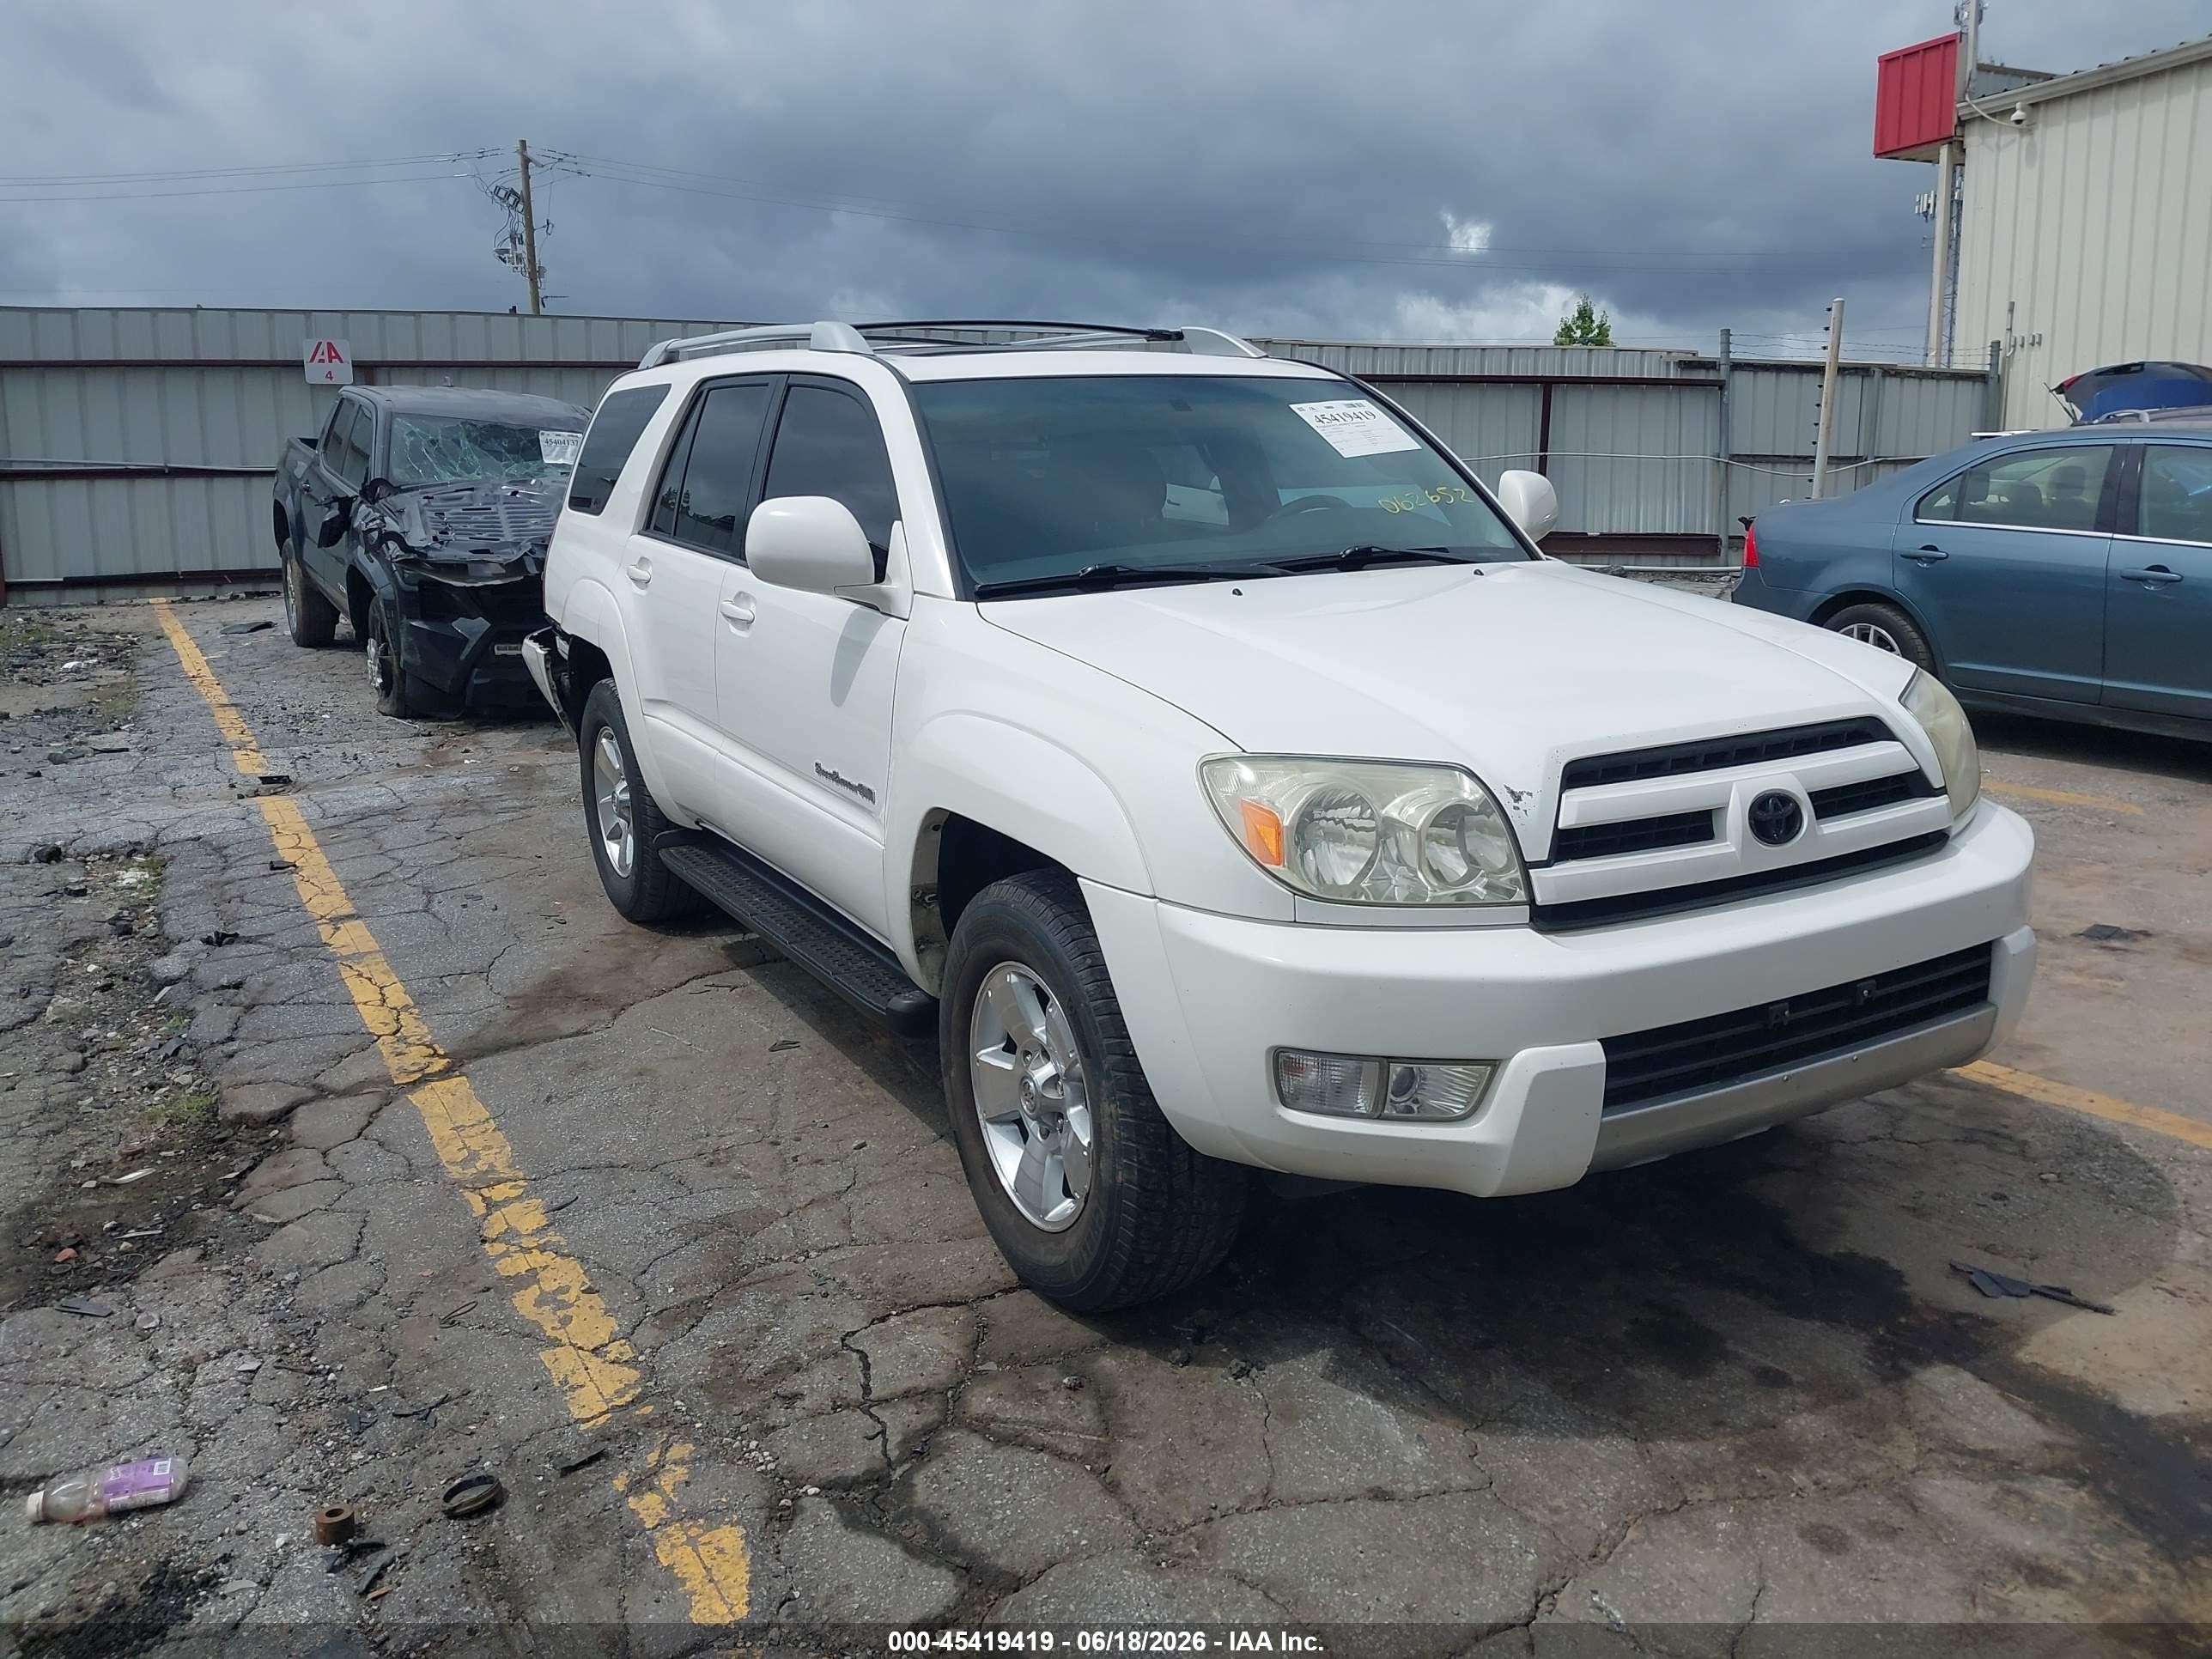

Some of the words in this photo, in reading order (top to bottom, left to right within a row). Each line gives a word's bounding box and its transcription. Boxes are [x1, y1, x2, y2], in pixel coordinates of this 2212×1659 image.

[325, 370, 334, 381] 4
[1314, 410, 1376, 424] 45419419
[544, 438, 578, 447] 45404137
[1377, 486, 1476, 514] 062652
